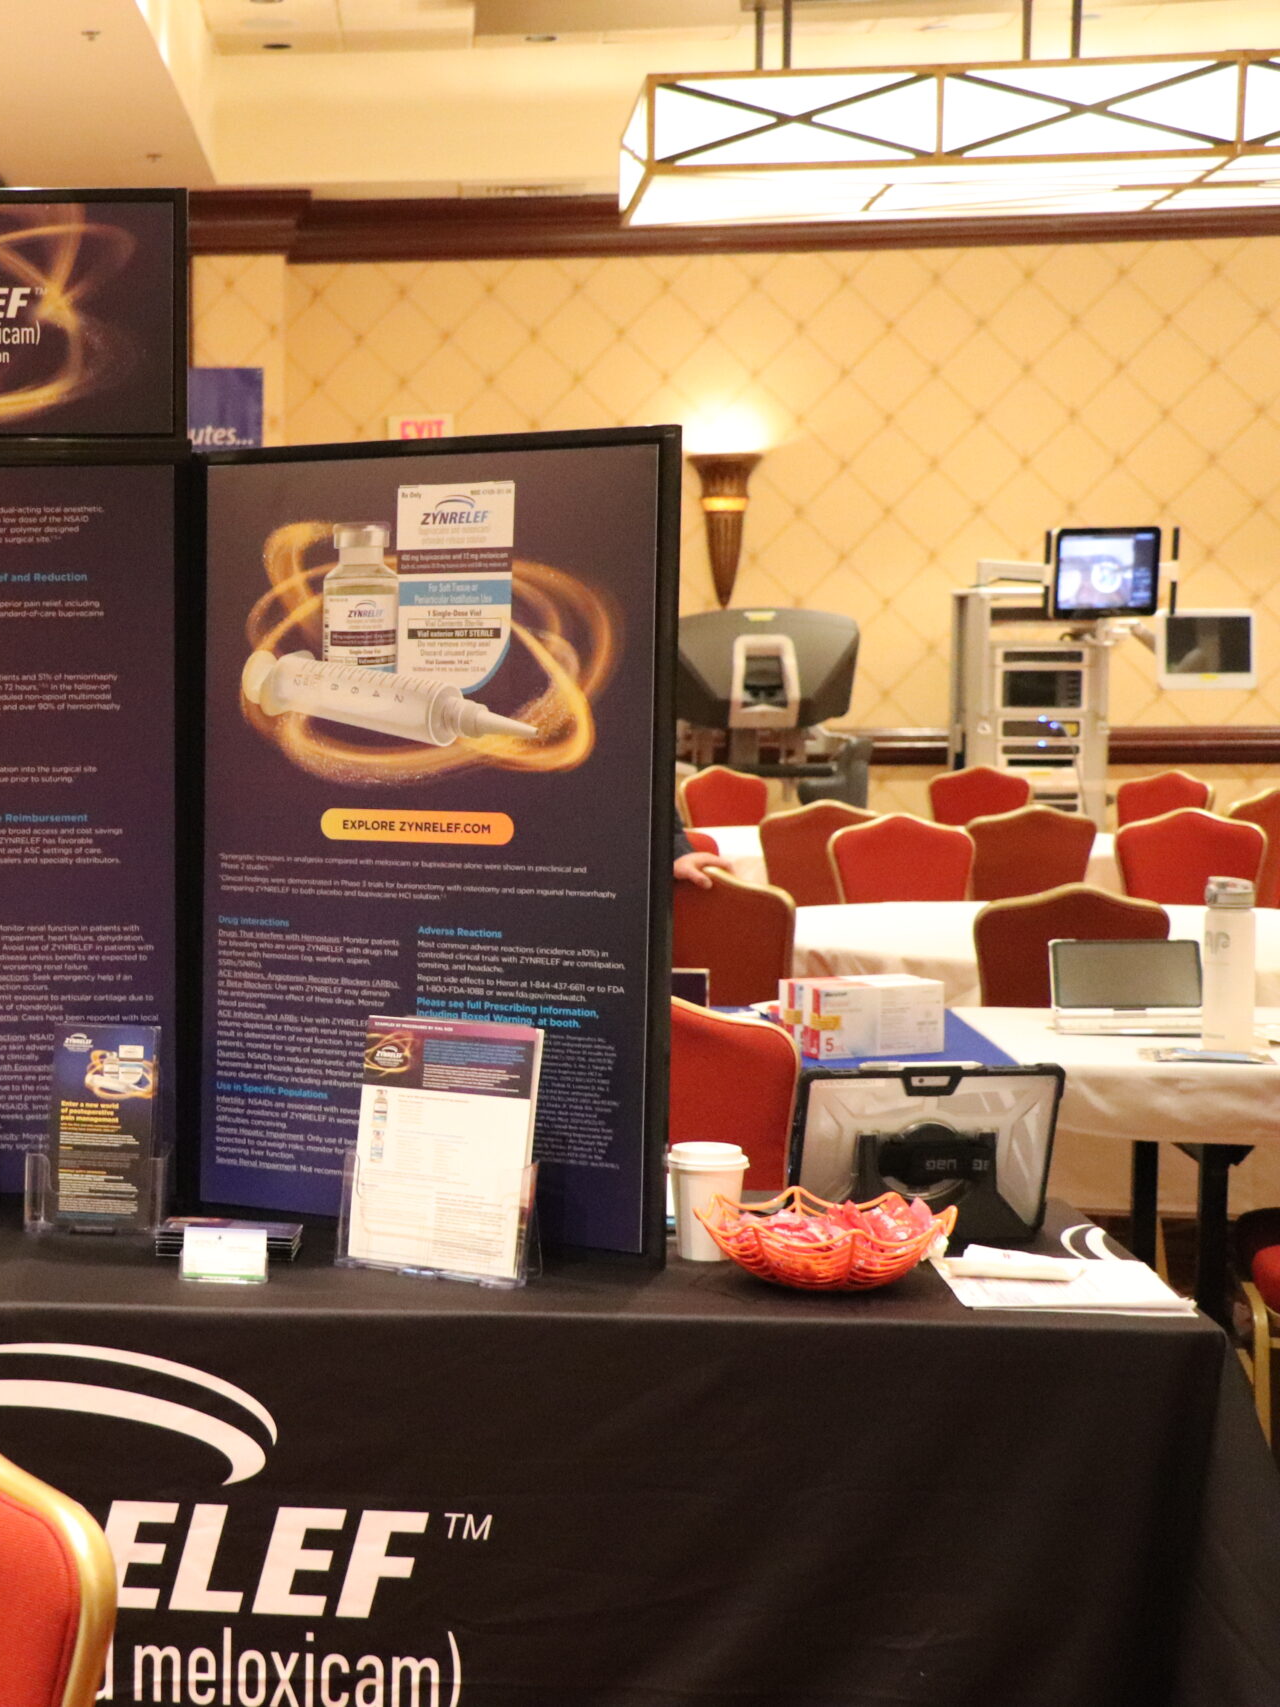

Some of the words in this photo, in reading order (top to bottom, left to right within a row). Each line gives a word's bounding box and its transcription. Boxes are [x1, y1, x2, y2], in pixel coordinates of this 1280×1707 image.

[400, 420, 444, 440] EXIT
[421, 510, 488, 525] ZYNRELEF
[11, 573, 30, 582] and
[34, 573, 87, 582] Reduction
[5, 814, 88, 822] Reimbursement
[343, 820, 395, 831] EXPLORE
[399, 821, 491, 834] ZYNRELEF.COM
[219, 916, 238, 925] Drug
[418, 927, 454, 936] Adverse
[457, 928, 502, 938] Reactions
[417, 975, 441, 983] Report
[462, 977, 484, 985] effects
[487, 978, 494, 986] to
[496, 979, 518, 987] Heron
[520, 980, 527, 988] at
[597, 985, 605, 993] to
[608, 986, 624, 994] FDA
[417, 997, 445, 1007] Please
[467, 999, 481, 1009] full
[484, 1002, 536, 1014] Prescribing
[540, 1005, 599, 1019] Information,
[462, 1012, 490, 1022] Boxed
[493, 1014, 535, 1027] Warning,
[538, 1018, 546, 1026] at
[550, 1019, 581, 1028] booth.
[217, 1081, 231, 1090] Use
[234, 1083, 241, 1091] in
[243, 1084, 276, 1095] Specific
[278, 1086, 328, 1099] Populations
[134, 1626, 462, 1707] meloxicam)
